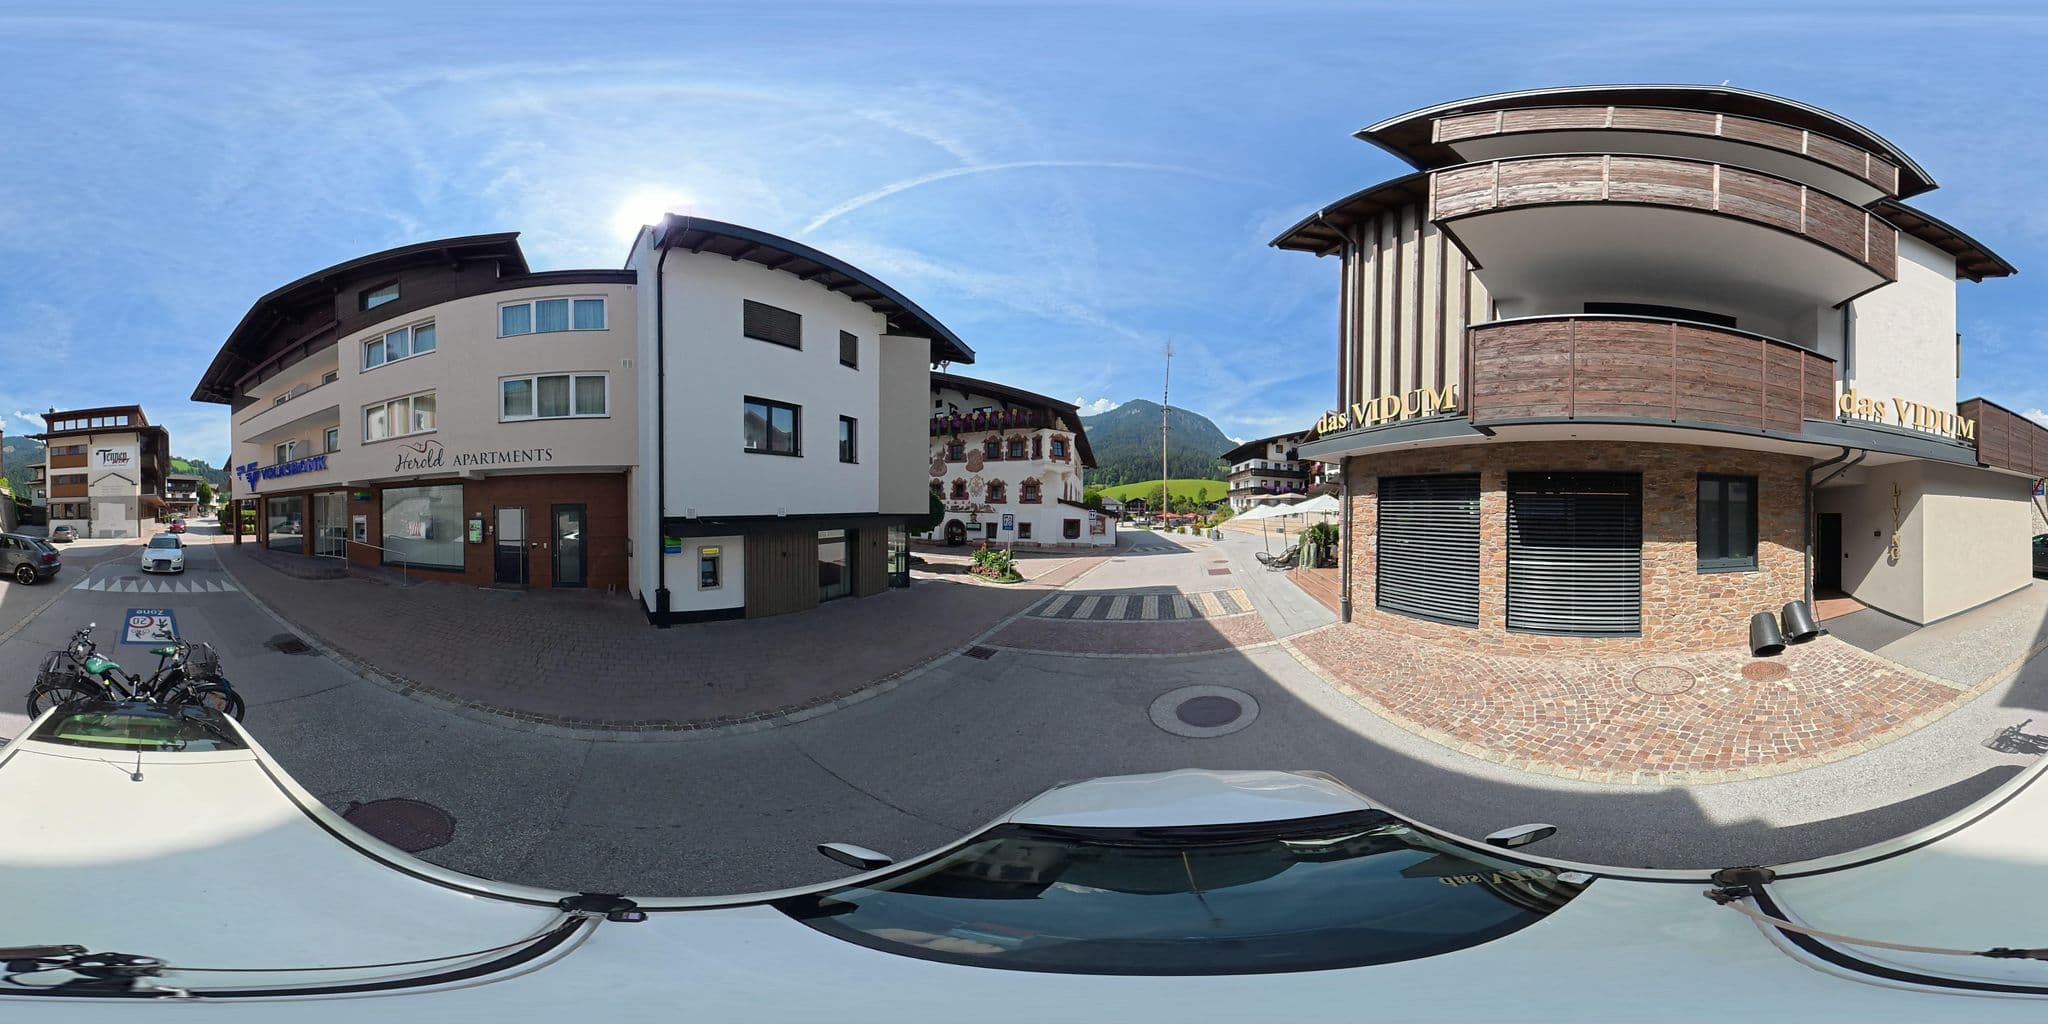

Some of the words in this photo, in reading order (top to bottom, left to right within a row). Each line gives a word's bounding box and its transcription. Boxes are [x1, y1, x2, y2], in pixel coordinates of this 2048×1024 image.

[1317, 411, 1347, 434] das
[1351, 384, 1457, 425] VIDUM
[1839, 389, 1885, 418] das
[1892, 398, 1976, 440] VIDUM
[261, 456, 328, 480] VOLKSBANK
[395, 449, 444, 472] Herold
[453, 449, 553, 466] APARTMENTS
[132, 617, 147, 625] 20
